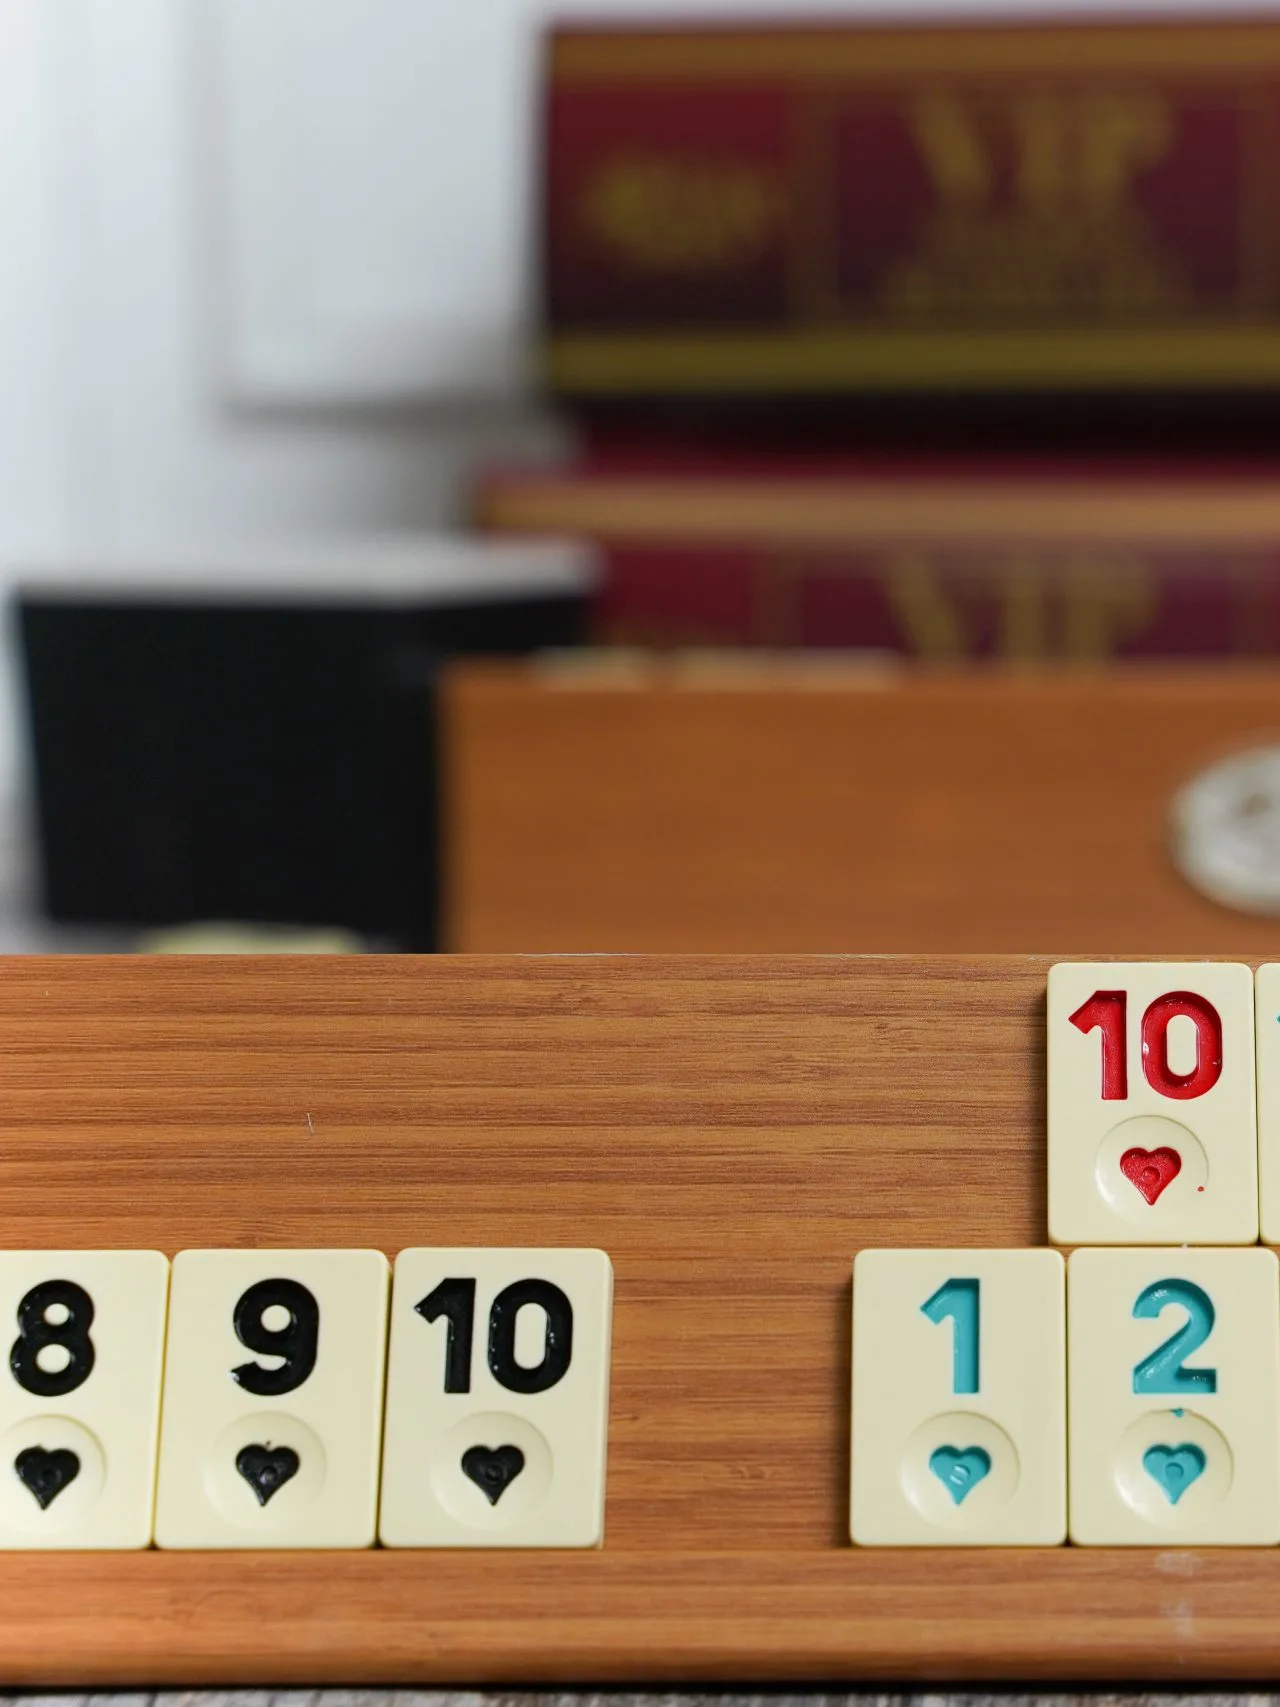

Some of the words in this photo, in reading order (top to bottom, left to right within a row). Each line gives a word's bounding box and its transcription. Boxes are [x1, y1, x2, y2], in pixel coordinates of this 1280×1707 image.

[1069, 991, 1222, 1099] 10
[10, 1280, 95, 1396] 8
[231, 1278, 319, 1395] 9
[415, 1278, 573, 1394] 10
[921, 1279, 979, 1393] 1
[1134, 1279, 1216, 1393] 2
